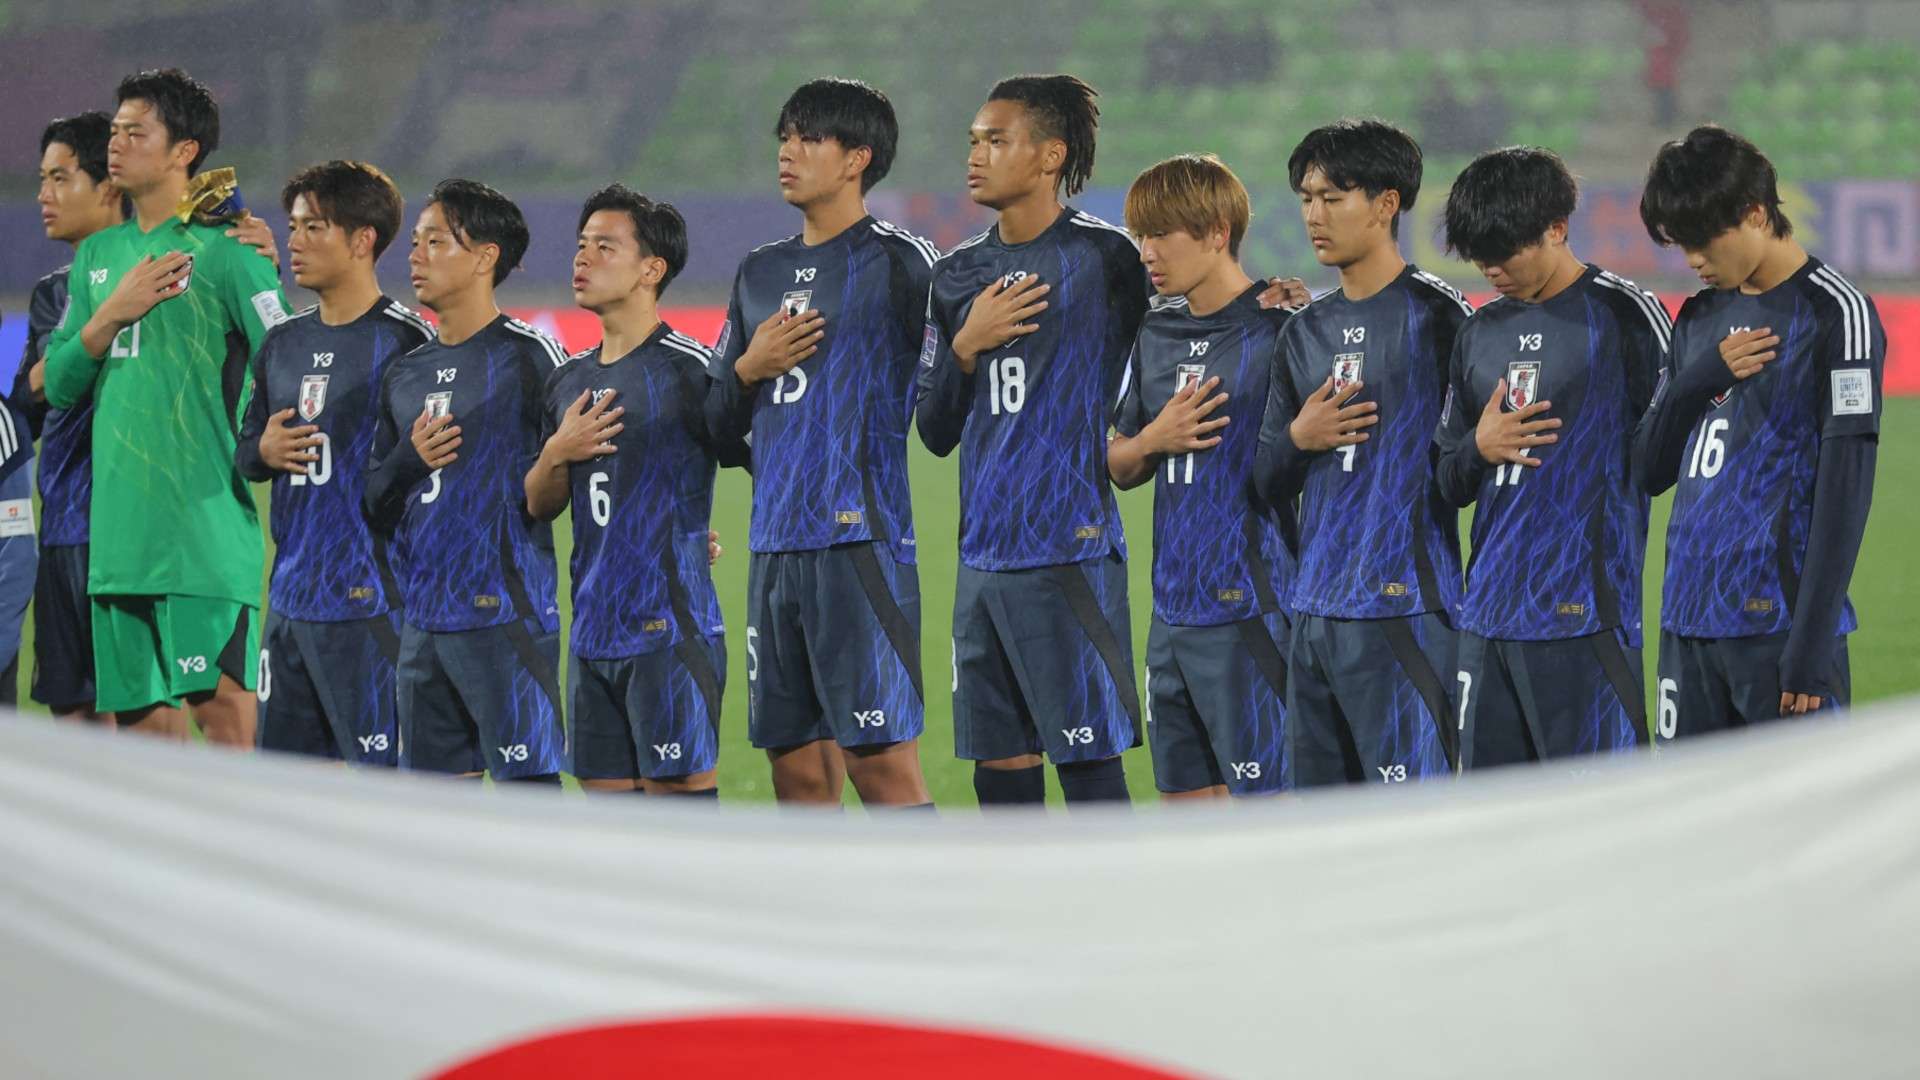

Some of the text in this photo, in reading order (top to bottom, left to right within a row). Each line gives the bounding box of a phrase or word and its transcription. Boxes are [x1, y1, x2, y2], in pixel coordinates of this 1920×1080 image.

[989, 356, 1026, 416] 18
[1688, 417, 1730, 479] 16
[589, 471, 611, 527] 6
[177, 655, 207, 675] Y-3
[853, 709, 885, 729] Y-3
[358, 733, 389, 753] Y-3
[1063, 727, 1094, 746] Y-3
[498, 743, 529, 763] Y-3
[653, 742, 682, 761] Y-3
[1231, 761, 1261, 781] Y-3
[1378, 764, 1407, 784] Y-3
